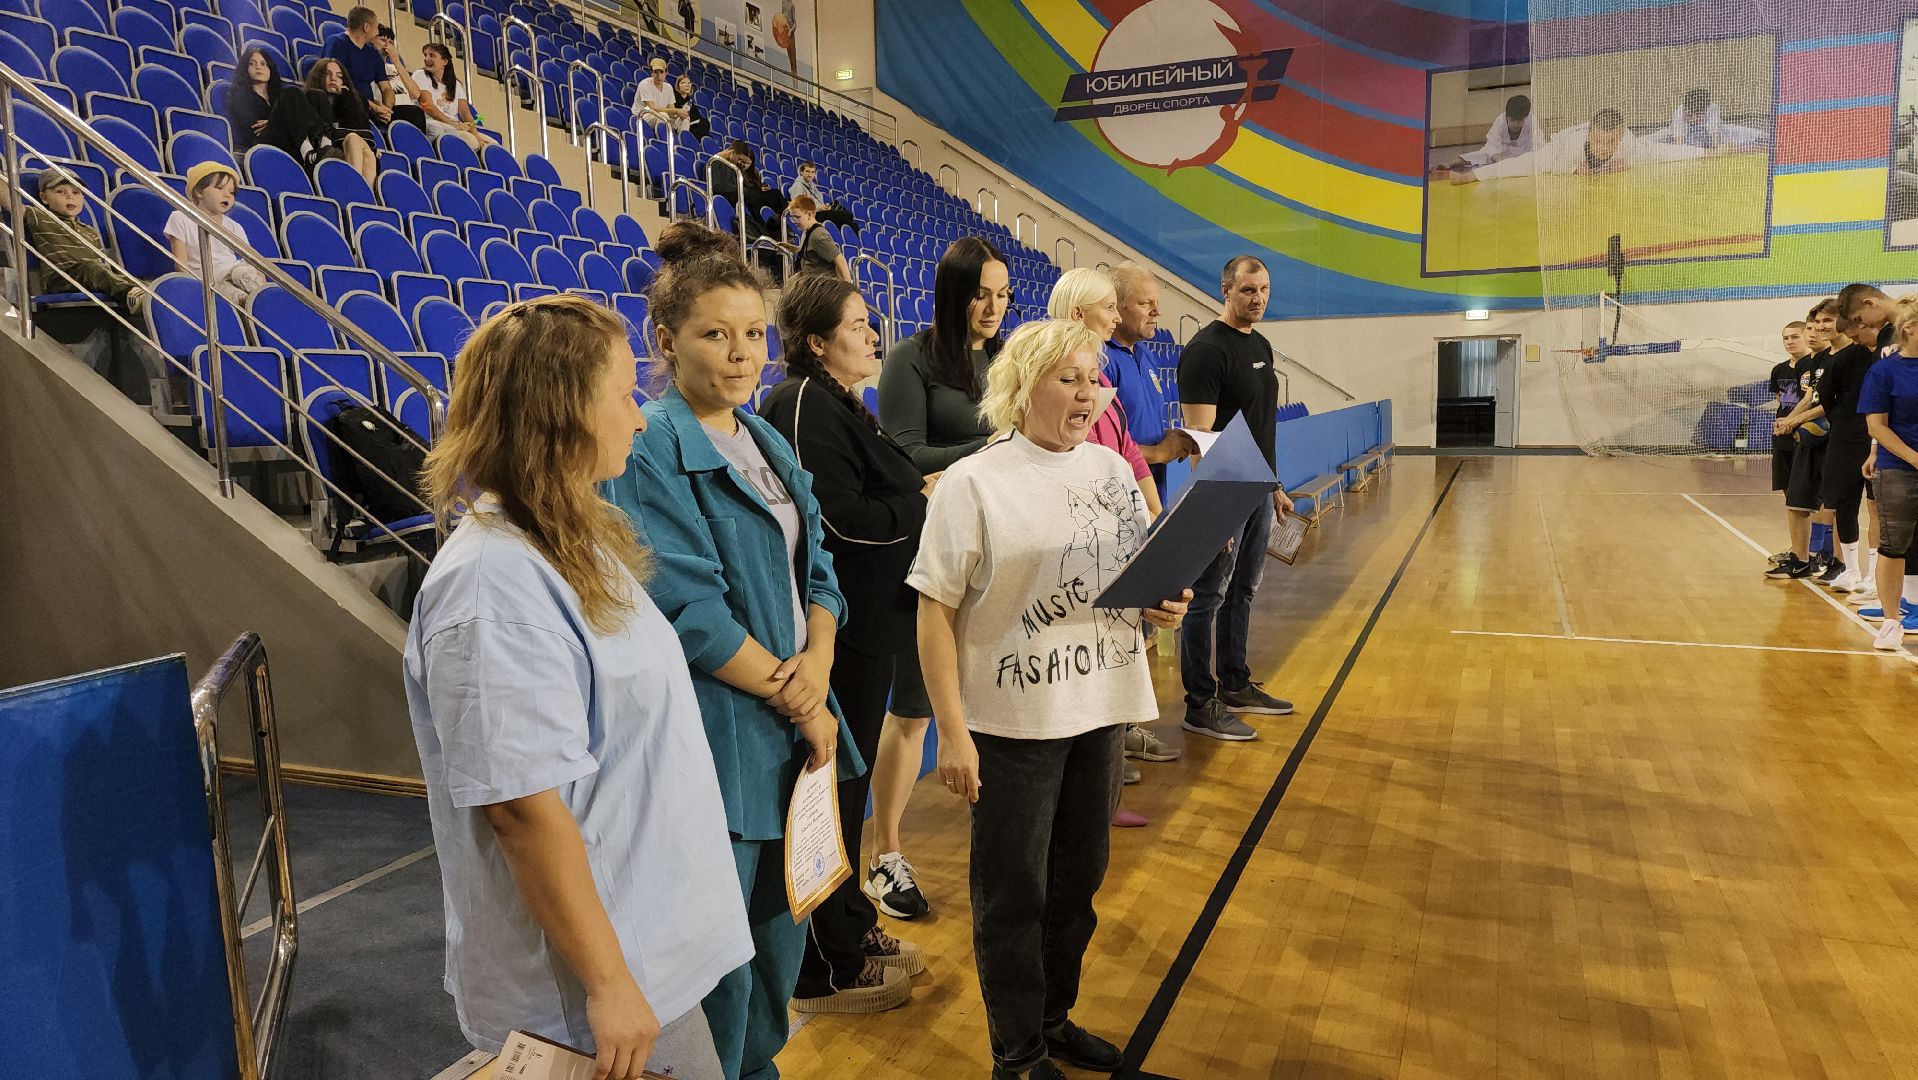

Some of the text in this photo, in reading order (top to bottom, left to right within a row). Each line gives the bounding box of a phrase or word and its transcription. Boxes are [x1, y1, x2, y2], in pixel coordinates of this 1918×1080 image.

[1086, 59, 1233, 93] ЮБИЛЕЙНЫЙ
[1113, 95, 1211, 115] ДВОРЕЦ СПОРТА
